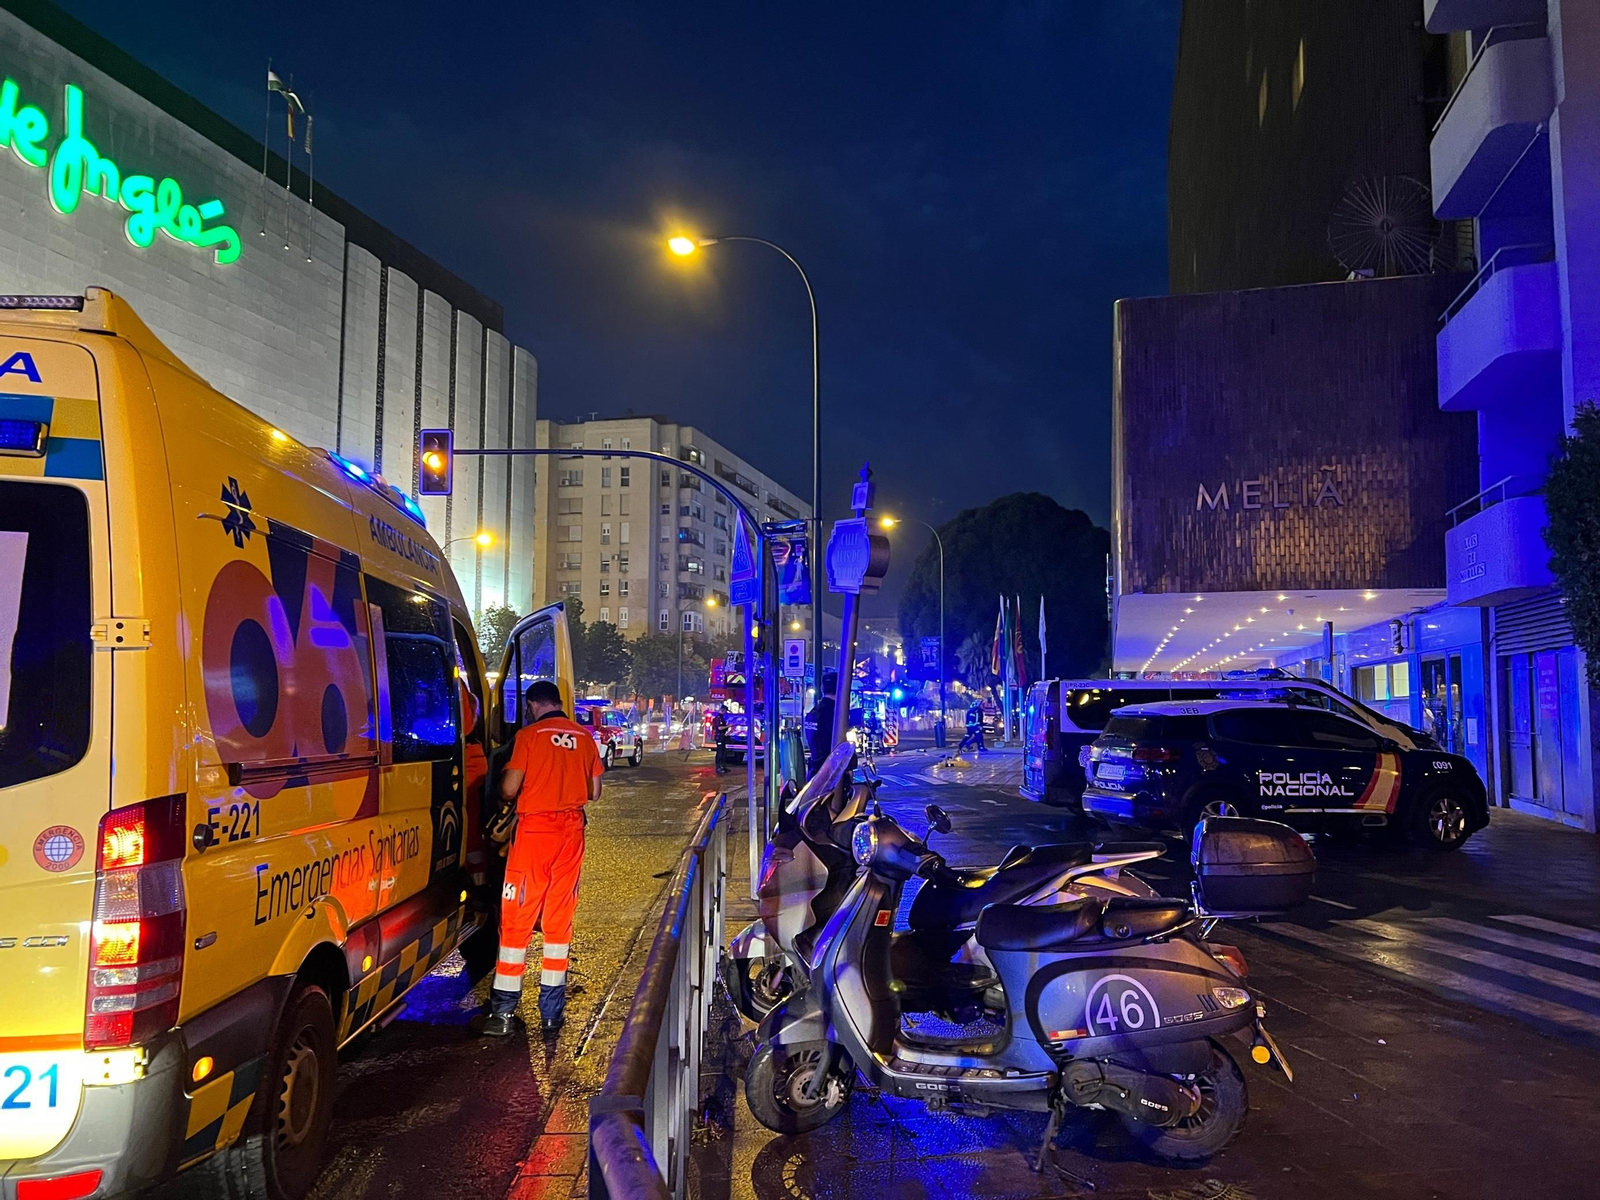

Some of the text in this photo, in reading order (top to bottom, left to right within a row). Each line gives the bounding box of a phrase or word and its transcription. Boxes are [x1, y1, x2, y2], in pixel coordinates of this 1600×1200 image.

[369, 513, 438, 577] AMBULANCIA
[550, 733, 577, 750] 061
[1260, 785, 1354, 796] NACIONAL
[35, 827, 83, 852] EMERGENCIA
[208, 800, 260, 847] E-221
[46, 861, 70, 870] 2000
[254, 819, 420, 926] Emergencias Sanitarias
[502, 882, 517, 901] 61
[1096, 989, 1145, 1031] 46
[1, 1063, 58, 1109] 21
